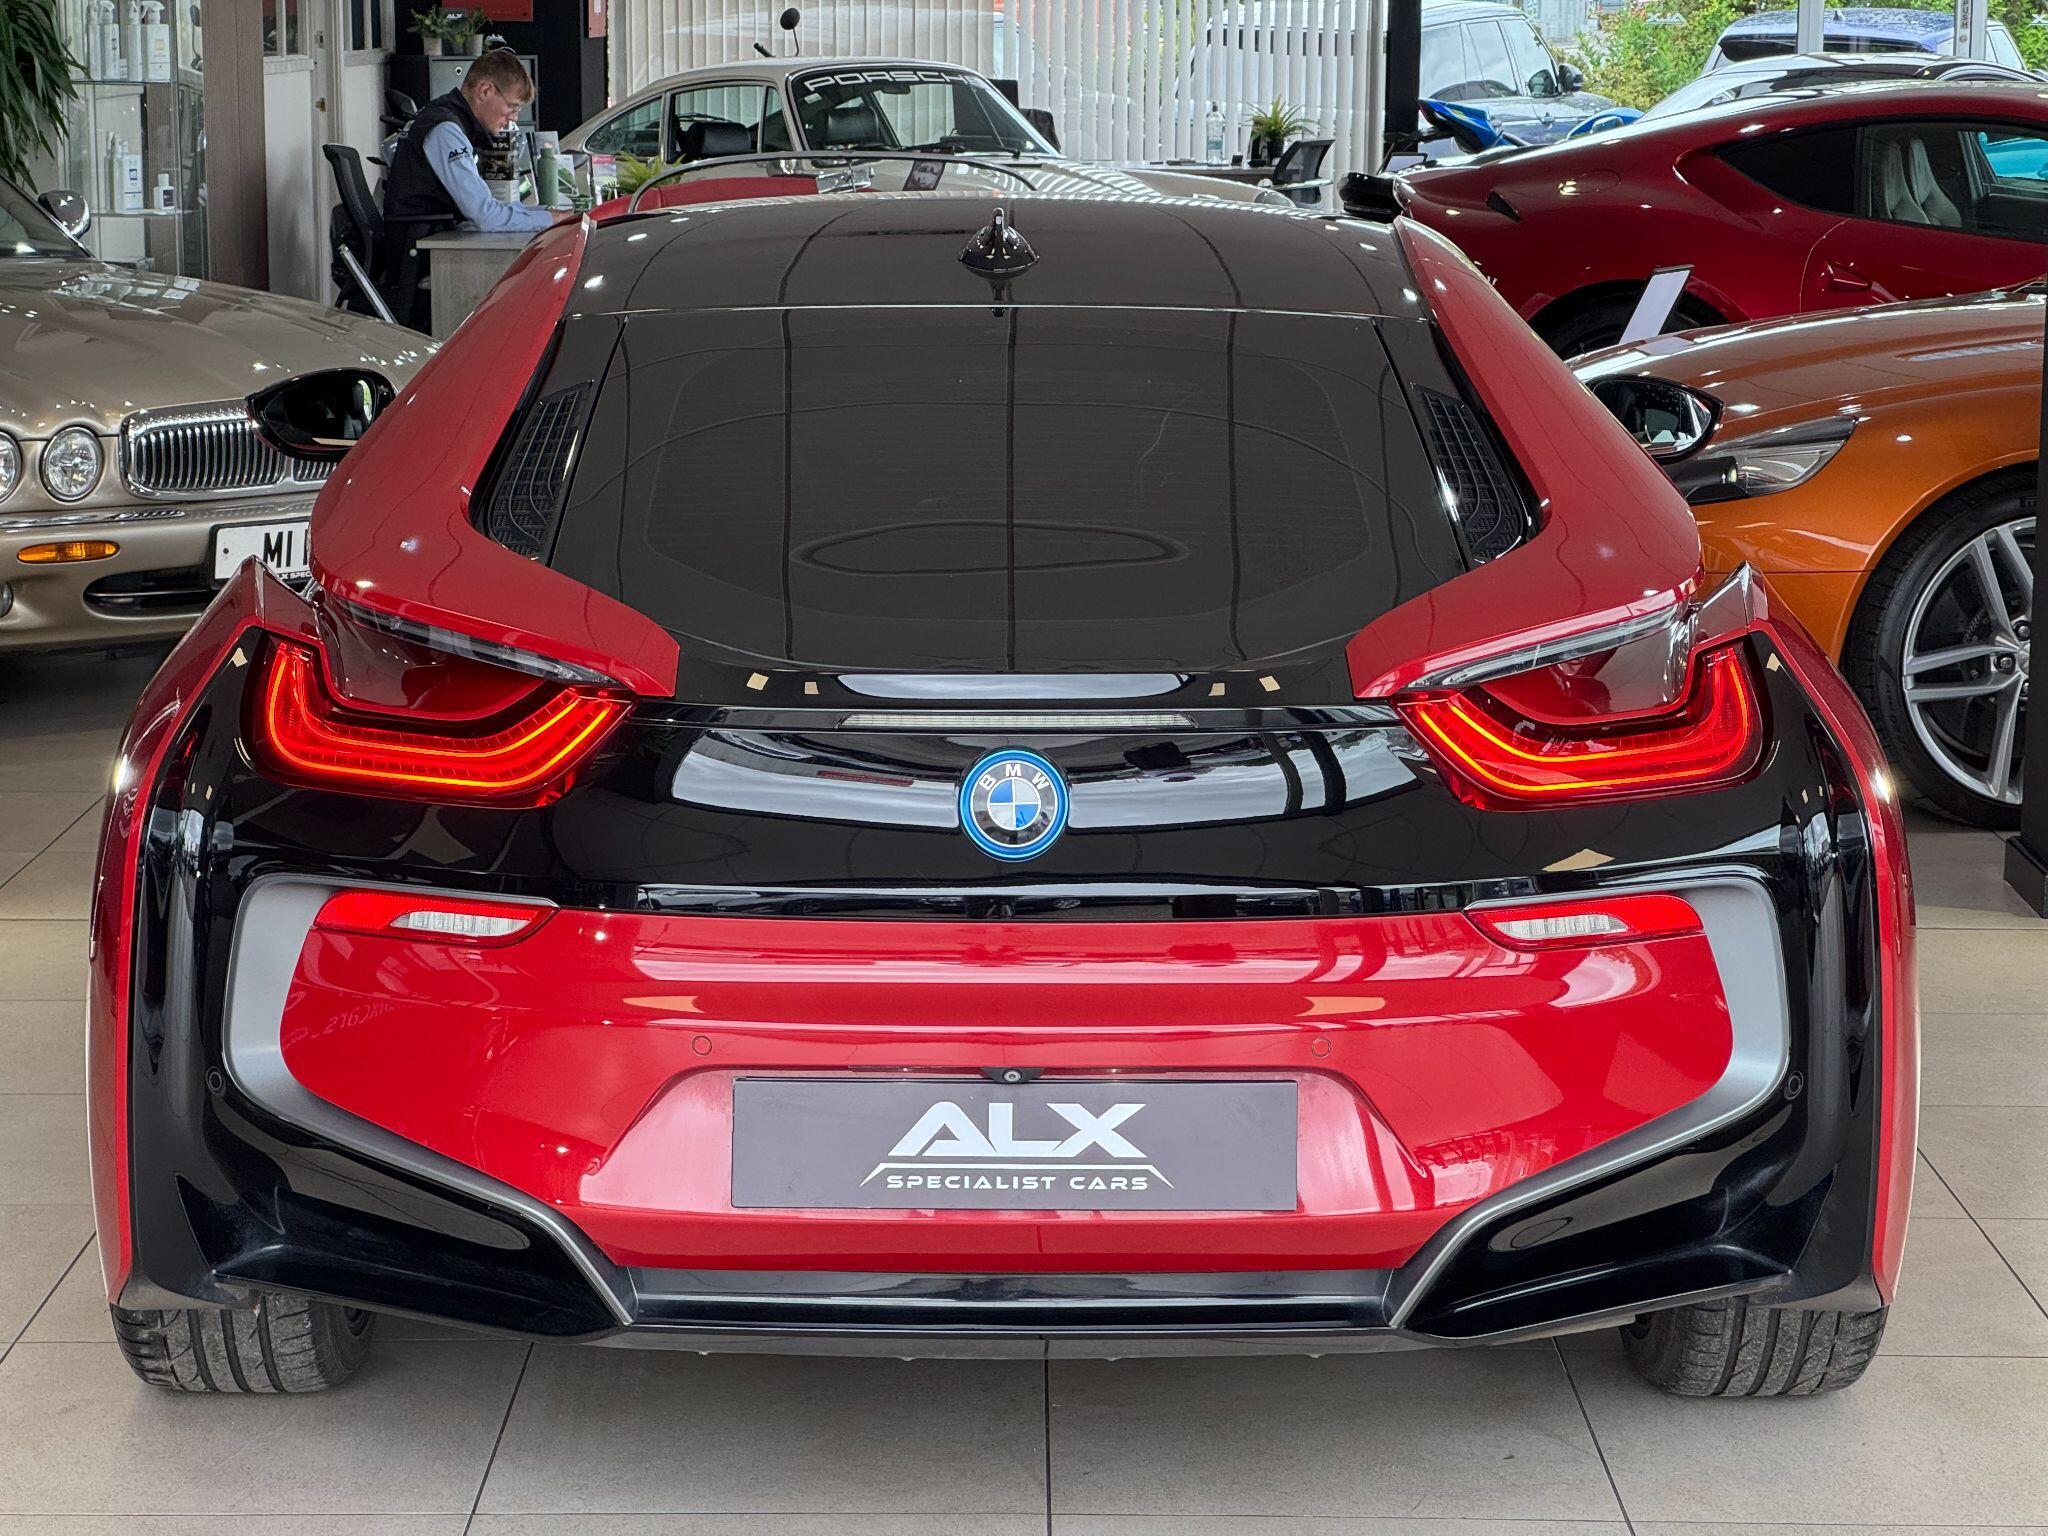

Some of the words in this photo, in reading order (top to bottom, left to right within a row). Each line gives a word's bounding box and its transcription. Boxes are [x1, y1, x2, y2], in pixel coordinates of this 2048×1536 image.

[804, 71, 984, 92] PORSCHE
[448, 147, 468, 159] ALX
[978, 763, 1050, 791] BMW
[887, 1101, 1148, 1158] ALX
[887, 1175, 1056, 1190] SPECIALIST
[1069, 1175, 1149, 1190] CARS
